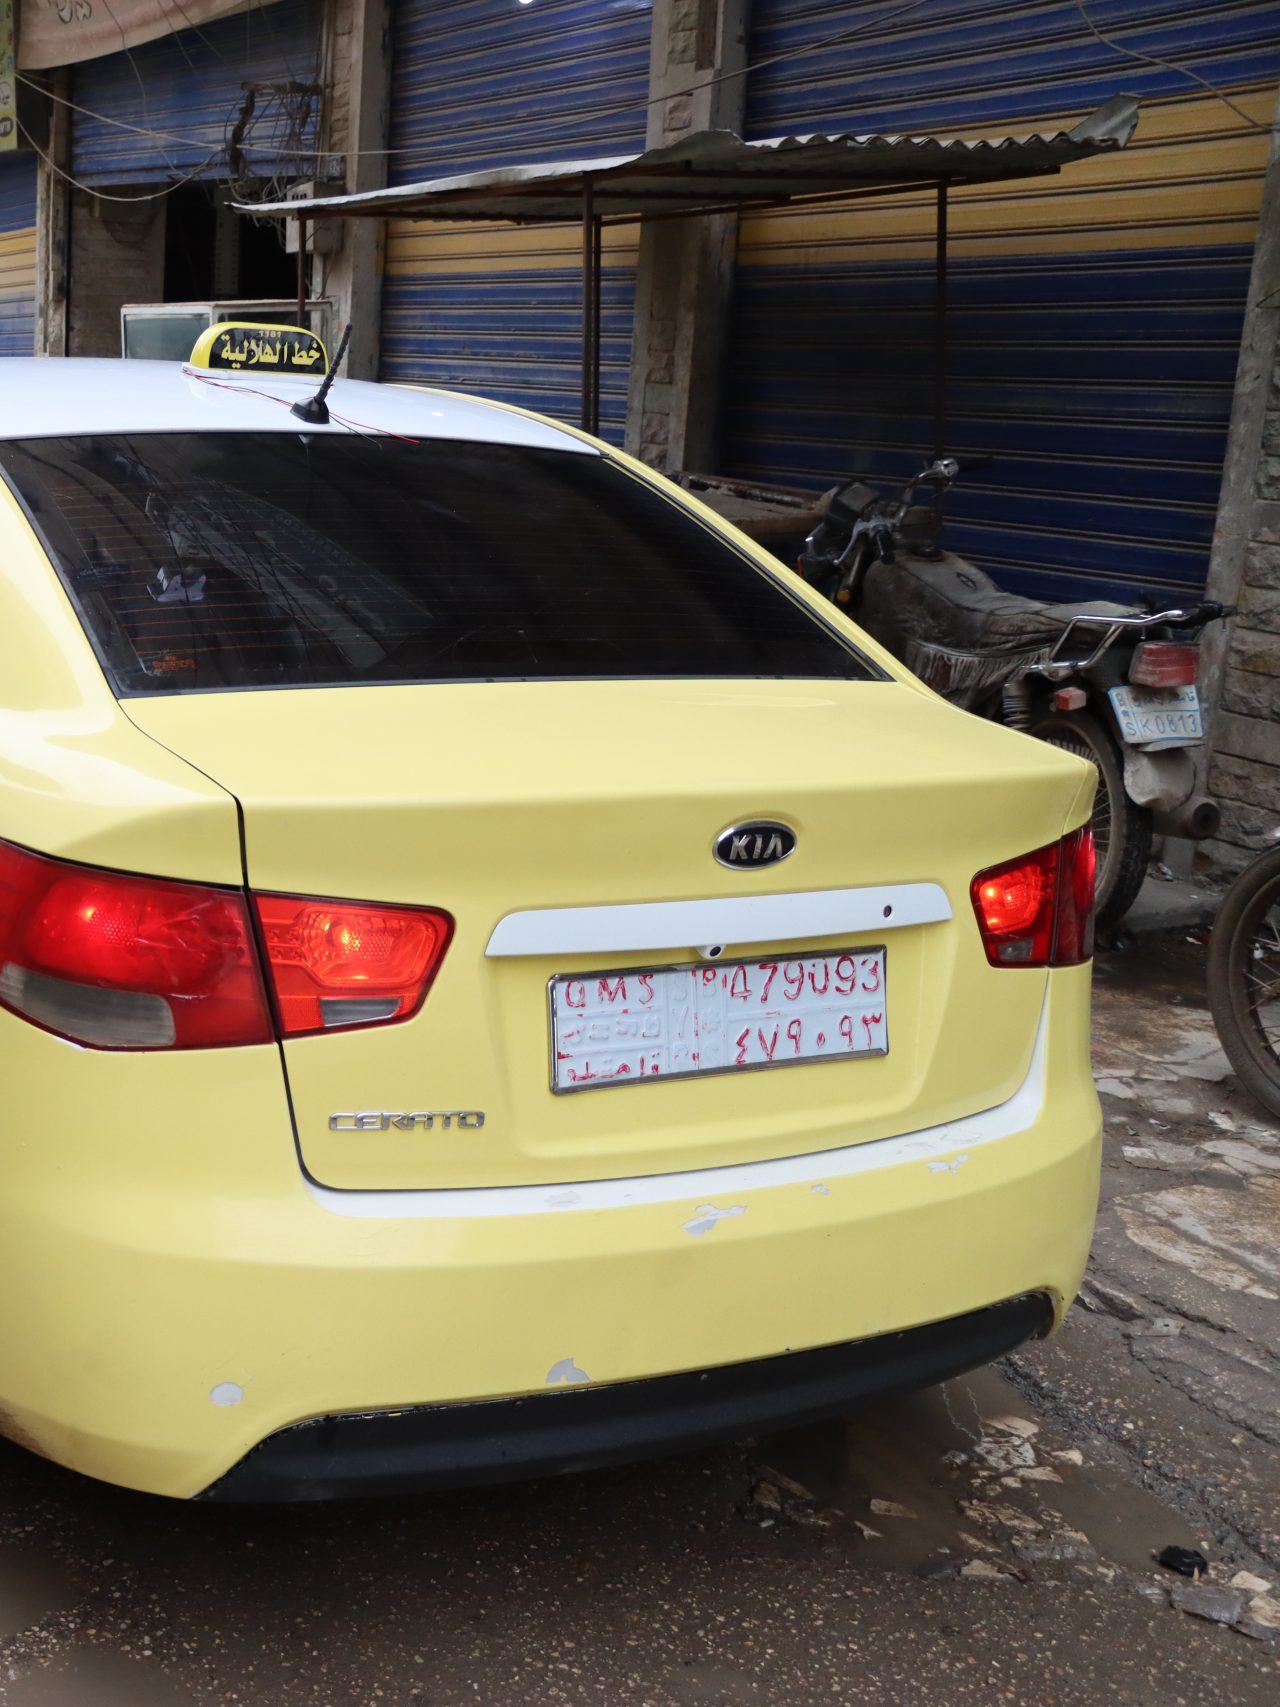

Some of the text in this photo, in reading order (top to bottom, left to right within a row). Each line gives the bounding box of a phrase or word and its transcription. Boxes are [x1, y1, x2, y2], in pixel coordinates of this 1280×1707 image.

[220, 334, 321, 369] خط الهلالية
[728, 833, 783, 861] KIA
[735, 1012, 882, 1065] ٤٧٩٠٩٣
[328, 1110, 486, 1131] CERATO
